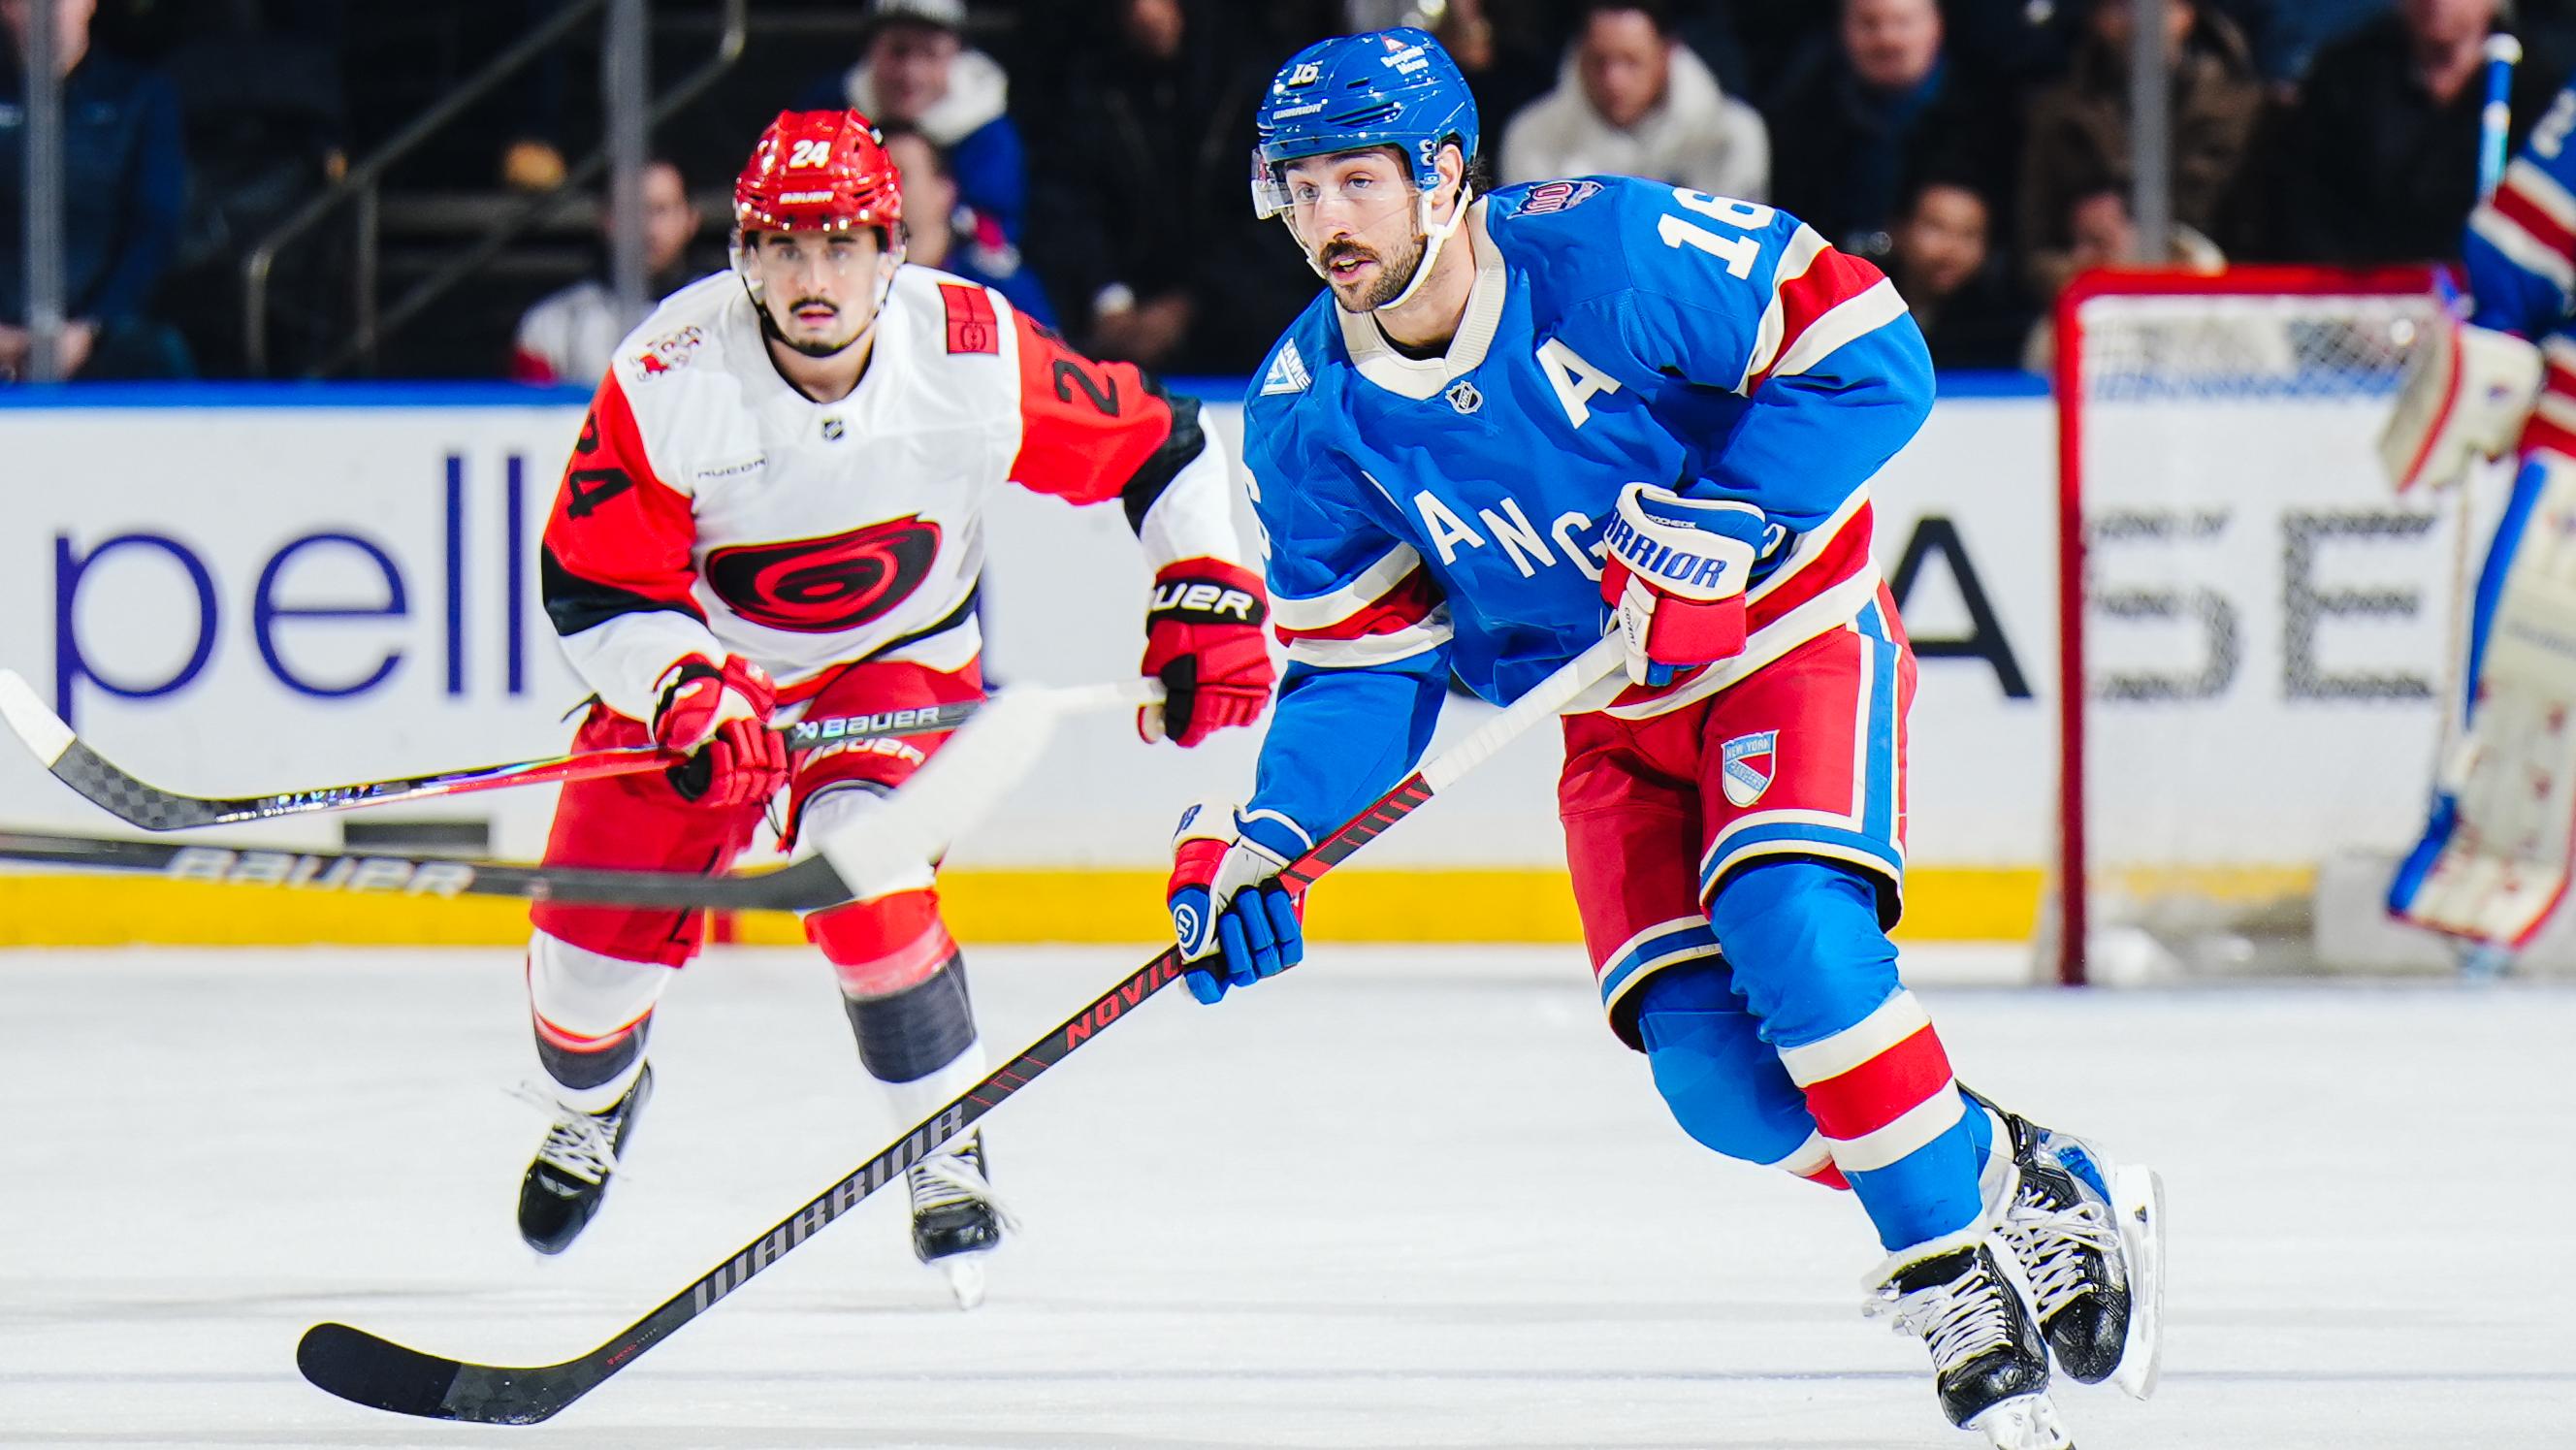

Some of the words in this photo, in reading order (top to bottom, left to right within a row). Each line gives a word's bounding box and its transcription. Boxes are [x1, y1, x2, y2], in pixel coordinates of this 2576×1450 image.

[1287, 62, 1320, 85] 16
[789, 140, 831, 169] 24
[1657, 186, 1777, 281] 16
[1534, 337, 1622, 430] A
[1606, 510, 1728, 589] RRIOR
[1151, 582, 1255, 621] UER
[1890, 512, 2436, 701] ASE
[821, 707, 940, 738] BAUER
[1726, 743, 1744, 760] NEW
[1748, 737, 1770, 753] YORK
[167, 846, 476, 900] BAUER
[694, 1102, 963, 1315] WARRIOR
